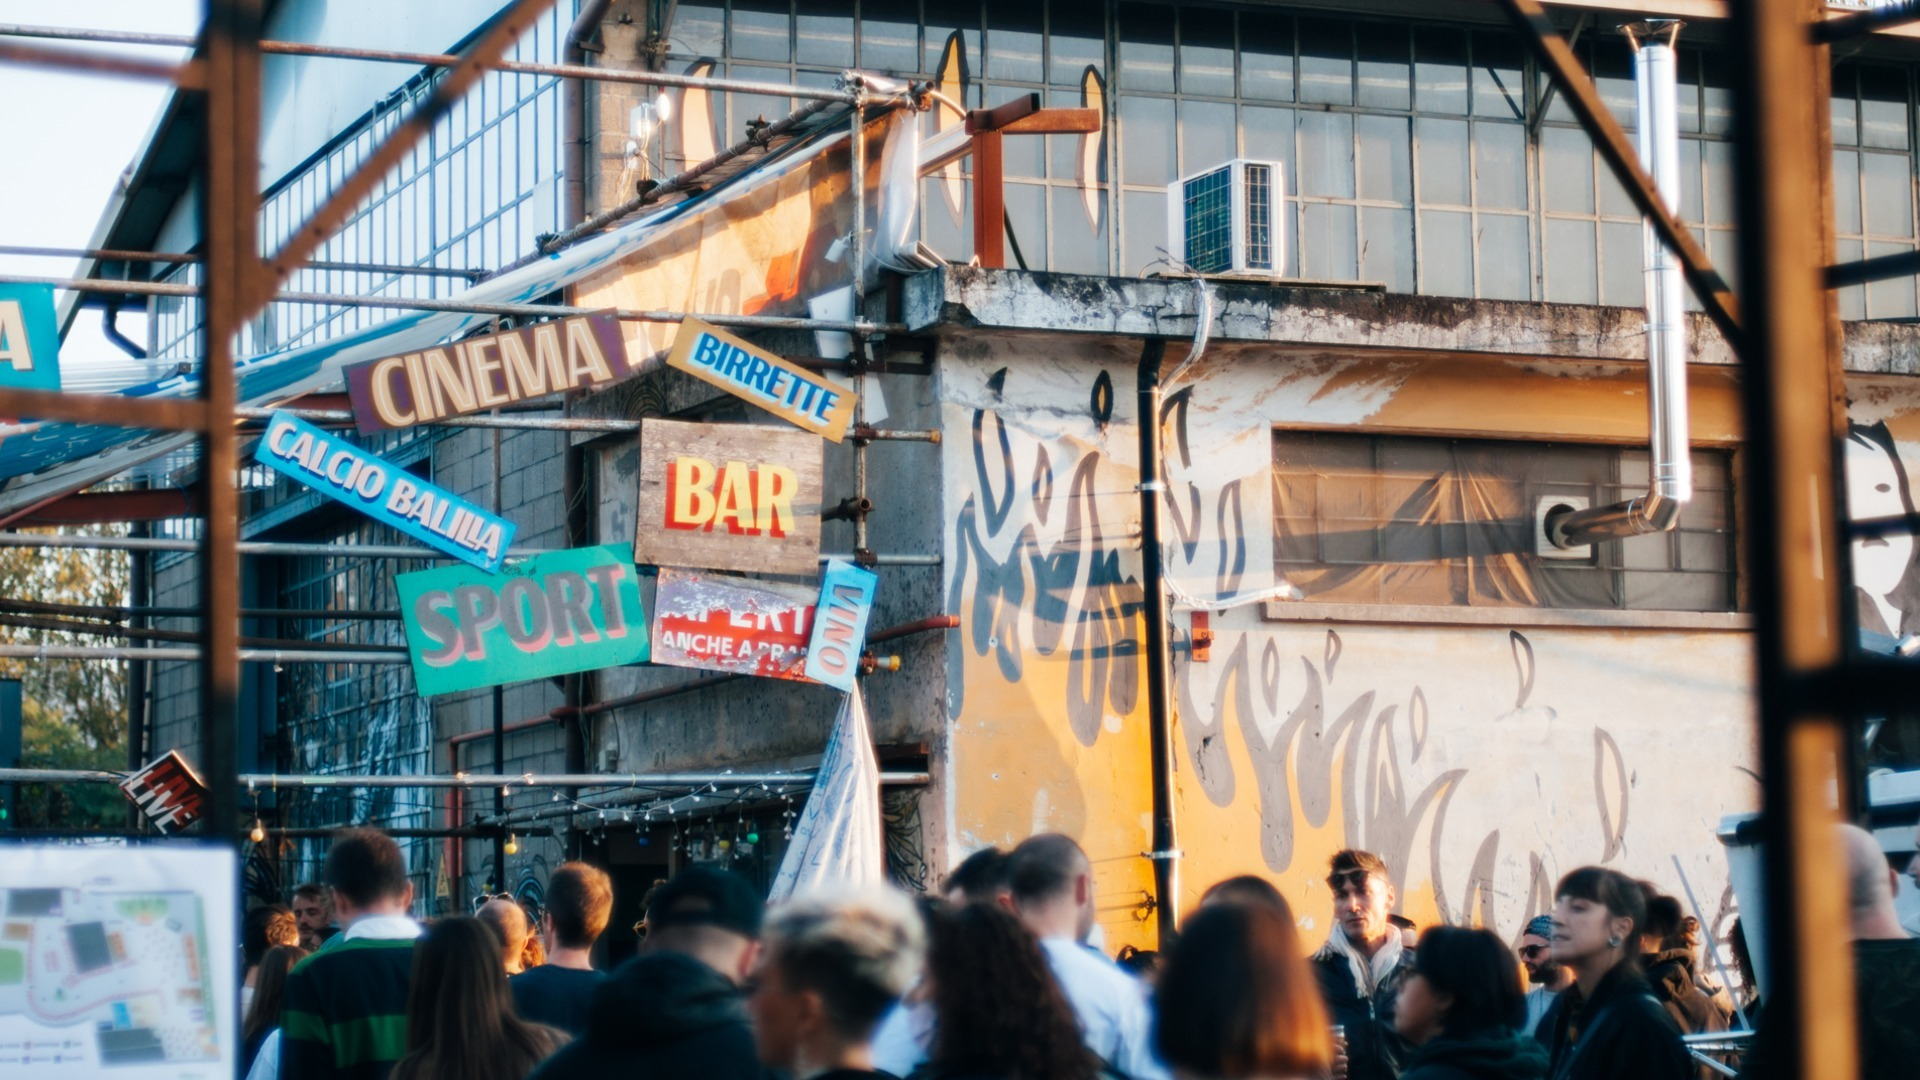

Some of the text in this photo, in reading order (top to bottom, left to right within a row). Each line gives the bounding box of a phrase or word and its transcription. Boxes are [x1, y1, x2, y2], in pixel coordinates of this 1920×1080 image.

[371, 316, 613, 427] CINEMA
[687, 330, 841, 427] BIRRETTE
[268, 421, 502, 561] CALCIO BALILLA
[664, 456, 799, 539] BAR
[414, 563, 628, 667] SPORT
[663, 630, 733, 656] ANCHE
[737, 639, 752, 659] A
[818, 583, 864, 676] VINO
